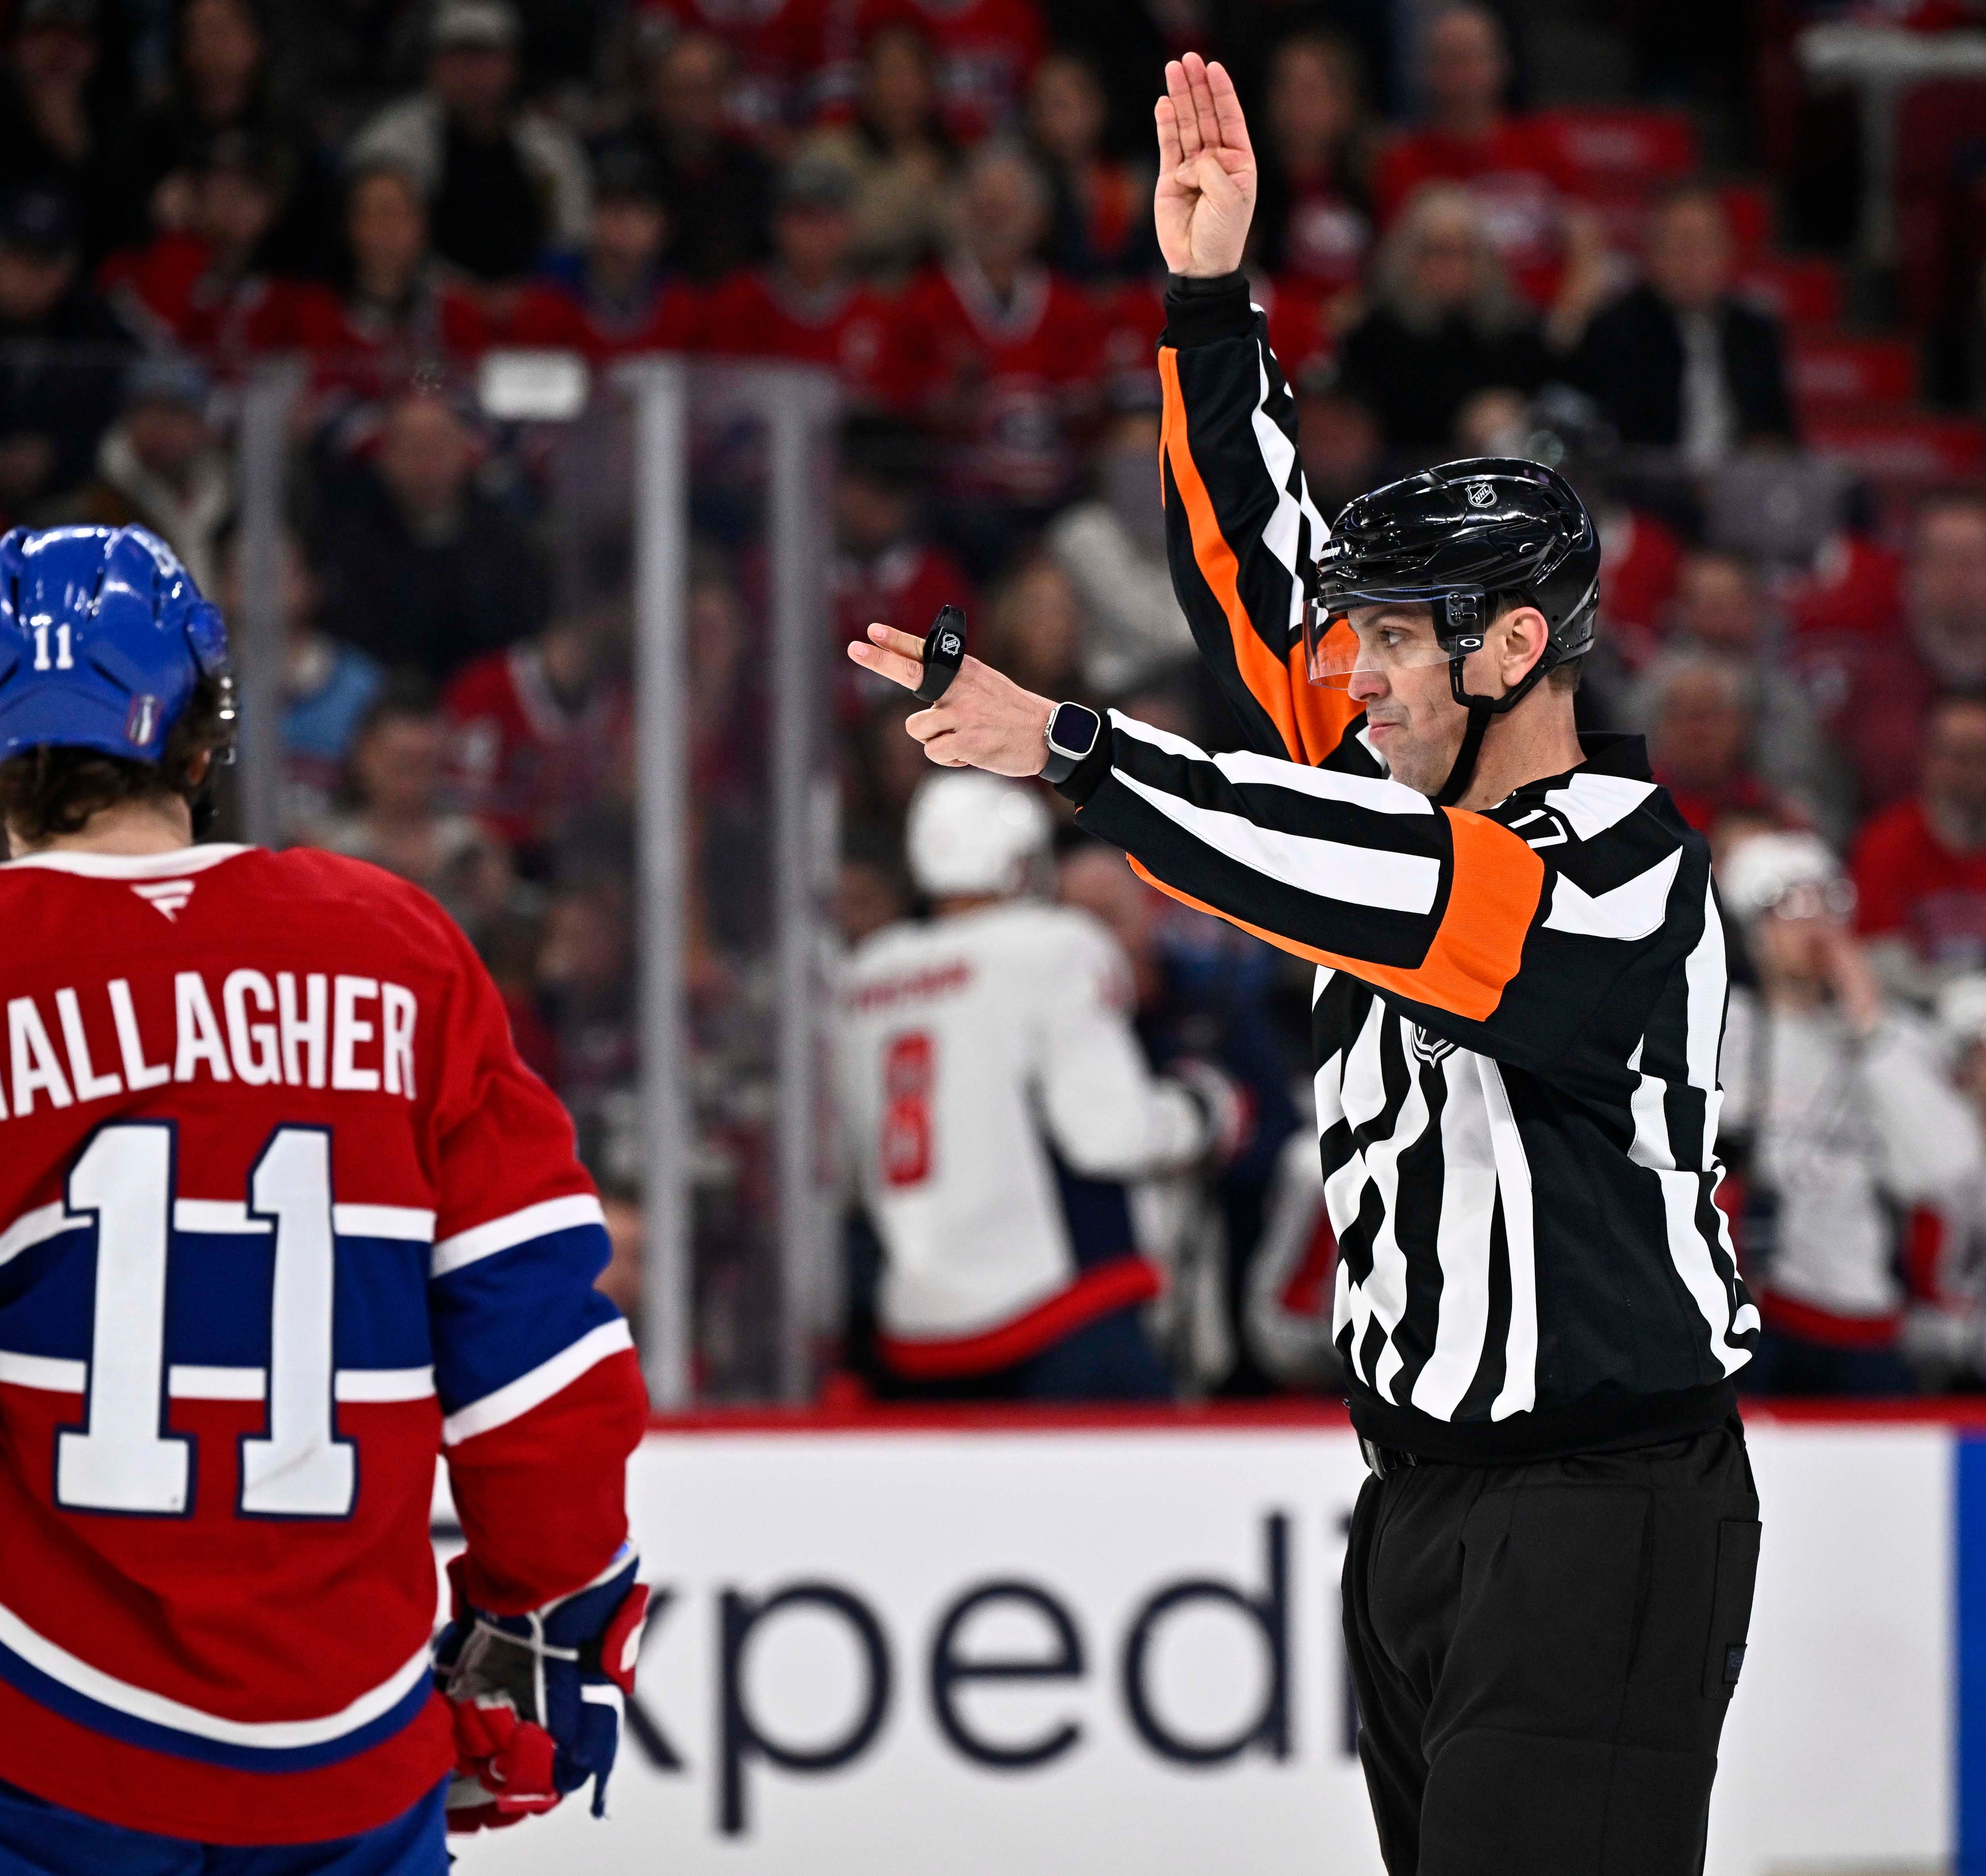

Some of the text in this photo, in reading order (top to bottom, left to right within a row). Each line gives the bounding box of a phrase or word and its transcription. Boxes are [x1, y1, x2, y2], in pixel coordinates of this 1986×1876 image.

[1475, 488, 1489, 503] NHL
[34, 622, 74, 671] 11
[1508, 809, 1568, 849] 17
[0, 968, 417, 1121] ALLAGHER
[53, 1118, 360, 1521] 11
